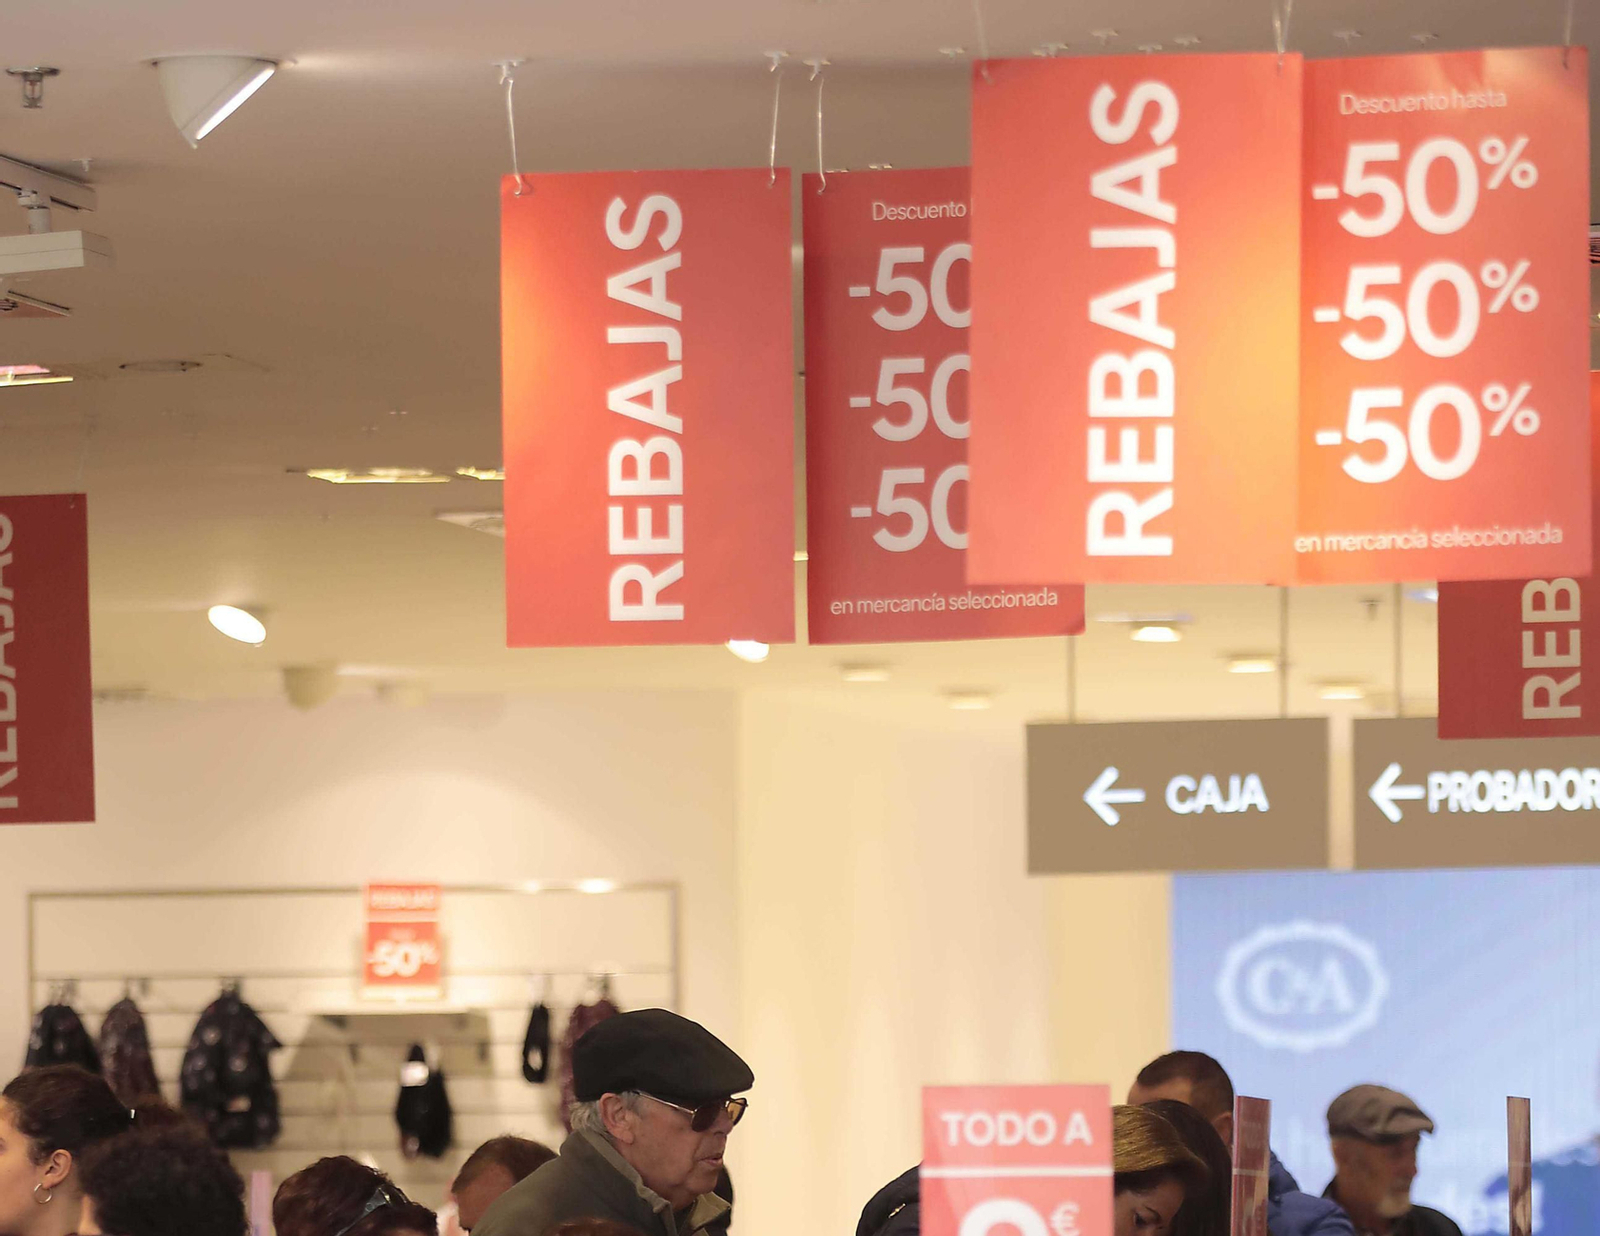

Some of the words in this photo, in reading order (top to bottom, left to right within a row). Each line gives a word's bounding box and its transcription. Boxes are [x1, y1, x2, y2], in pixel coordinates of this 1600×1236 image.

[1339, 93, 1449, 115] Descuento
[1451, 87, 1508, 109] hasta
[1312, 134, 1539, 238] -50%
[872, 201, 967, 221] Descuento
[1085, 80, 1181, 557] REBAJAS
[1313, 259, 1540, 361] -50%
[606, 194, 684, 621] REBAJAS
[1314, 382, 1541, 484] -50%
[1294, 534, 1323, 553] en
[1324, 527, 1428, 551] mercancía
[1430, 521, 1563, 548] seleccionada
[831, 602, 854, 615] en
[857, 592, 945, 613] mercancía
[949, 587, 1058, 611] seleccionada
[1165, 773, 1269, 814] CAJA
[1427, 767, 1600, 814] PROBADOR
[941, 1110, 1057, 1147] TODO
[1064, 1110, 1094, 1146] A
